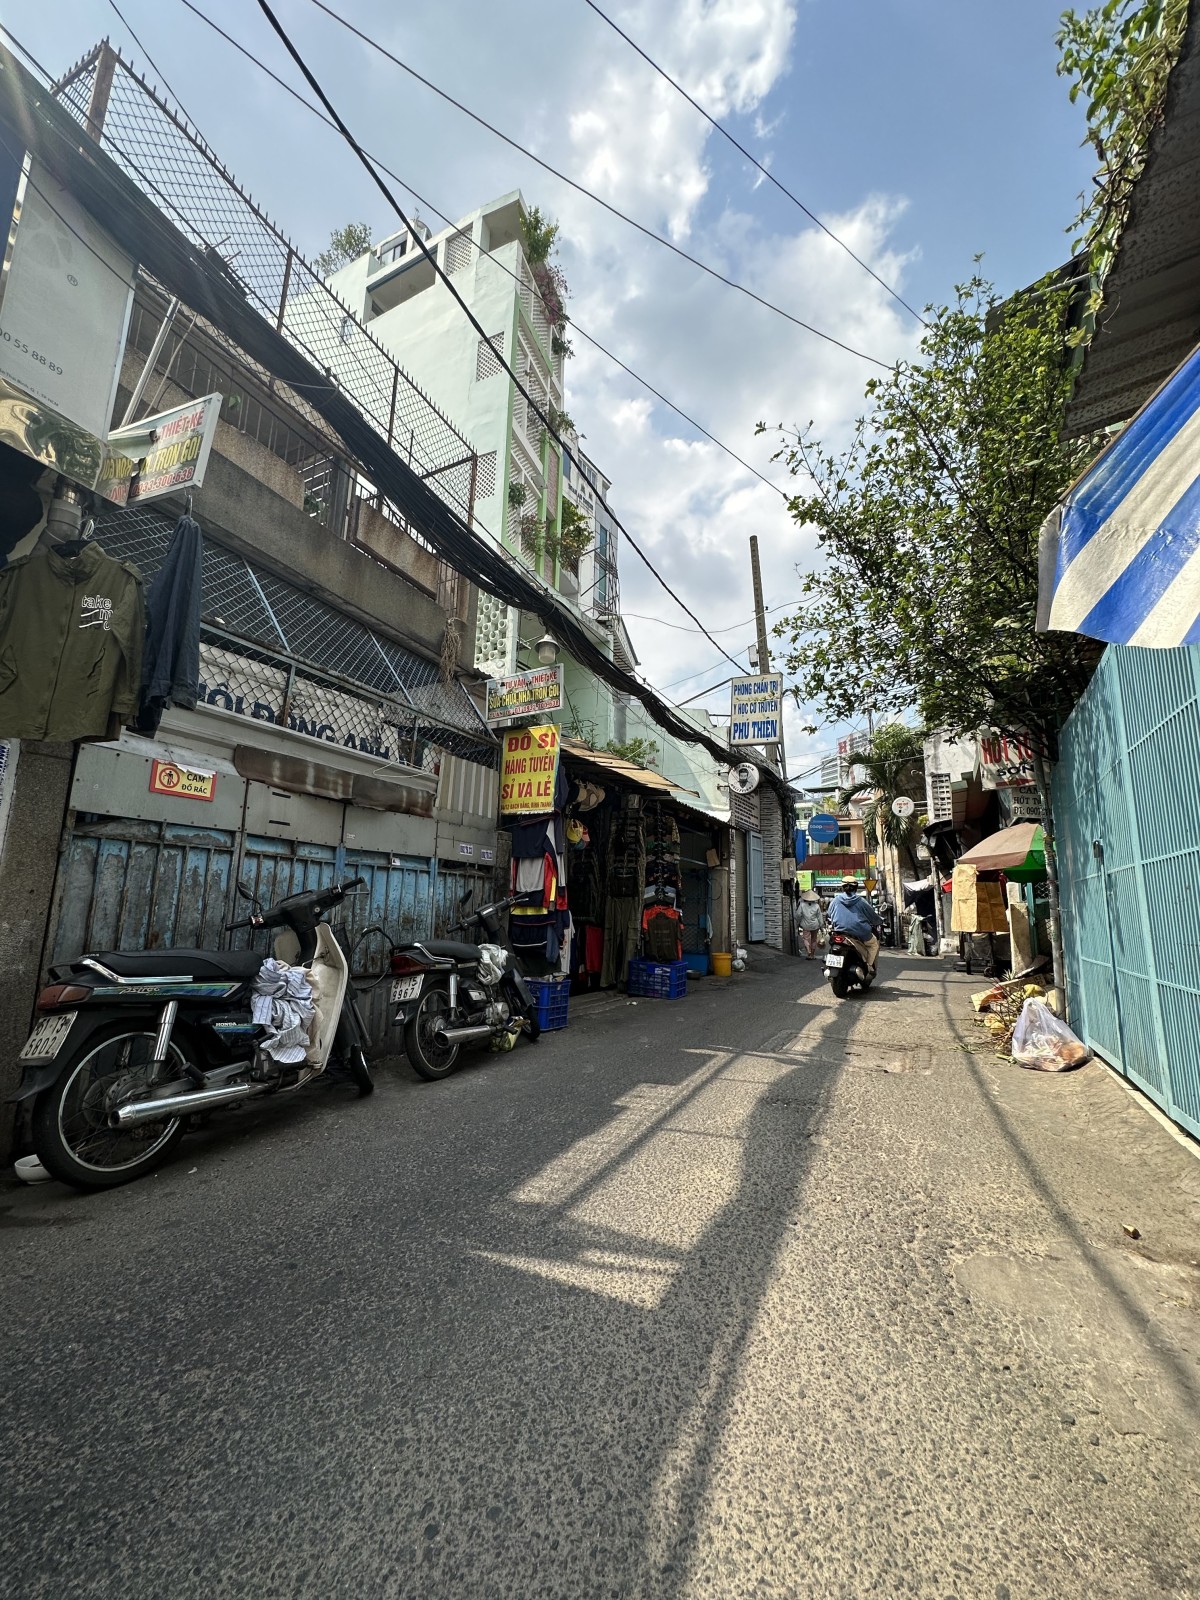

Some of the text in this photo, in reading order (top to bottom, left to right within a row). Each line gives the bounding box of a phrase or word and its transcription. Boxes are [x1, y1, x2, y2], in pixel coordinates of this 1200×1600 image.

[13, 338, 29, 354] 55
[31, 350, 46, 366] 88
[48, 361, 63, 376] 89
[82, 594, 112, 609] take
[733, 716, 777, 741] PHÚ THIỆN
[504, 749, 555, 775] HÀNG TUYỂN
[194, 785, 208, 794] RÁC
[517, 778, 533, 798] VÀ
[536, 774, 552, 797] LẺ
[392, 987, 415, 1001] 9967
[24, 1036, 58, 1057] 5802
